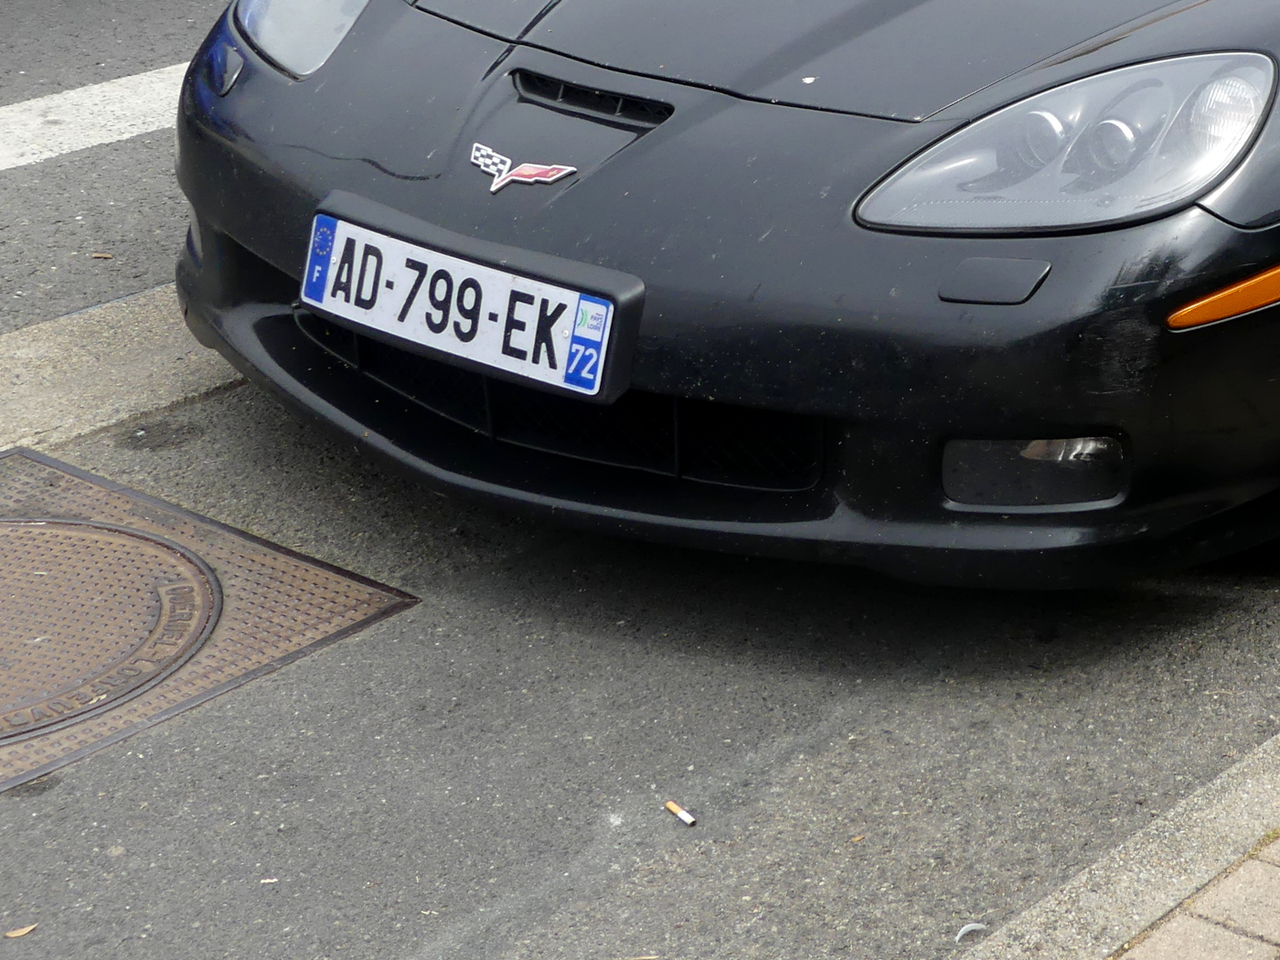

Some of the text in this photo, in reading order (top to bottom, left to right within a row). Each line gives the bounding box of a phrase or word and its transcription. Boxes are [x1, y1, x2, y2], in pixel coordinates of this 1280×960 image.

[311, 236, 568, 371] F AD-799-EK
[567, 343, 599, 380] 72
